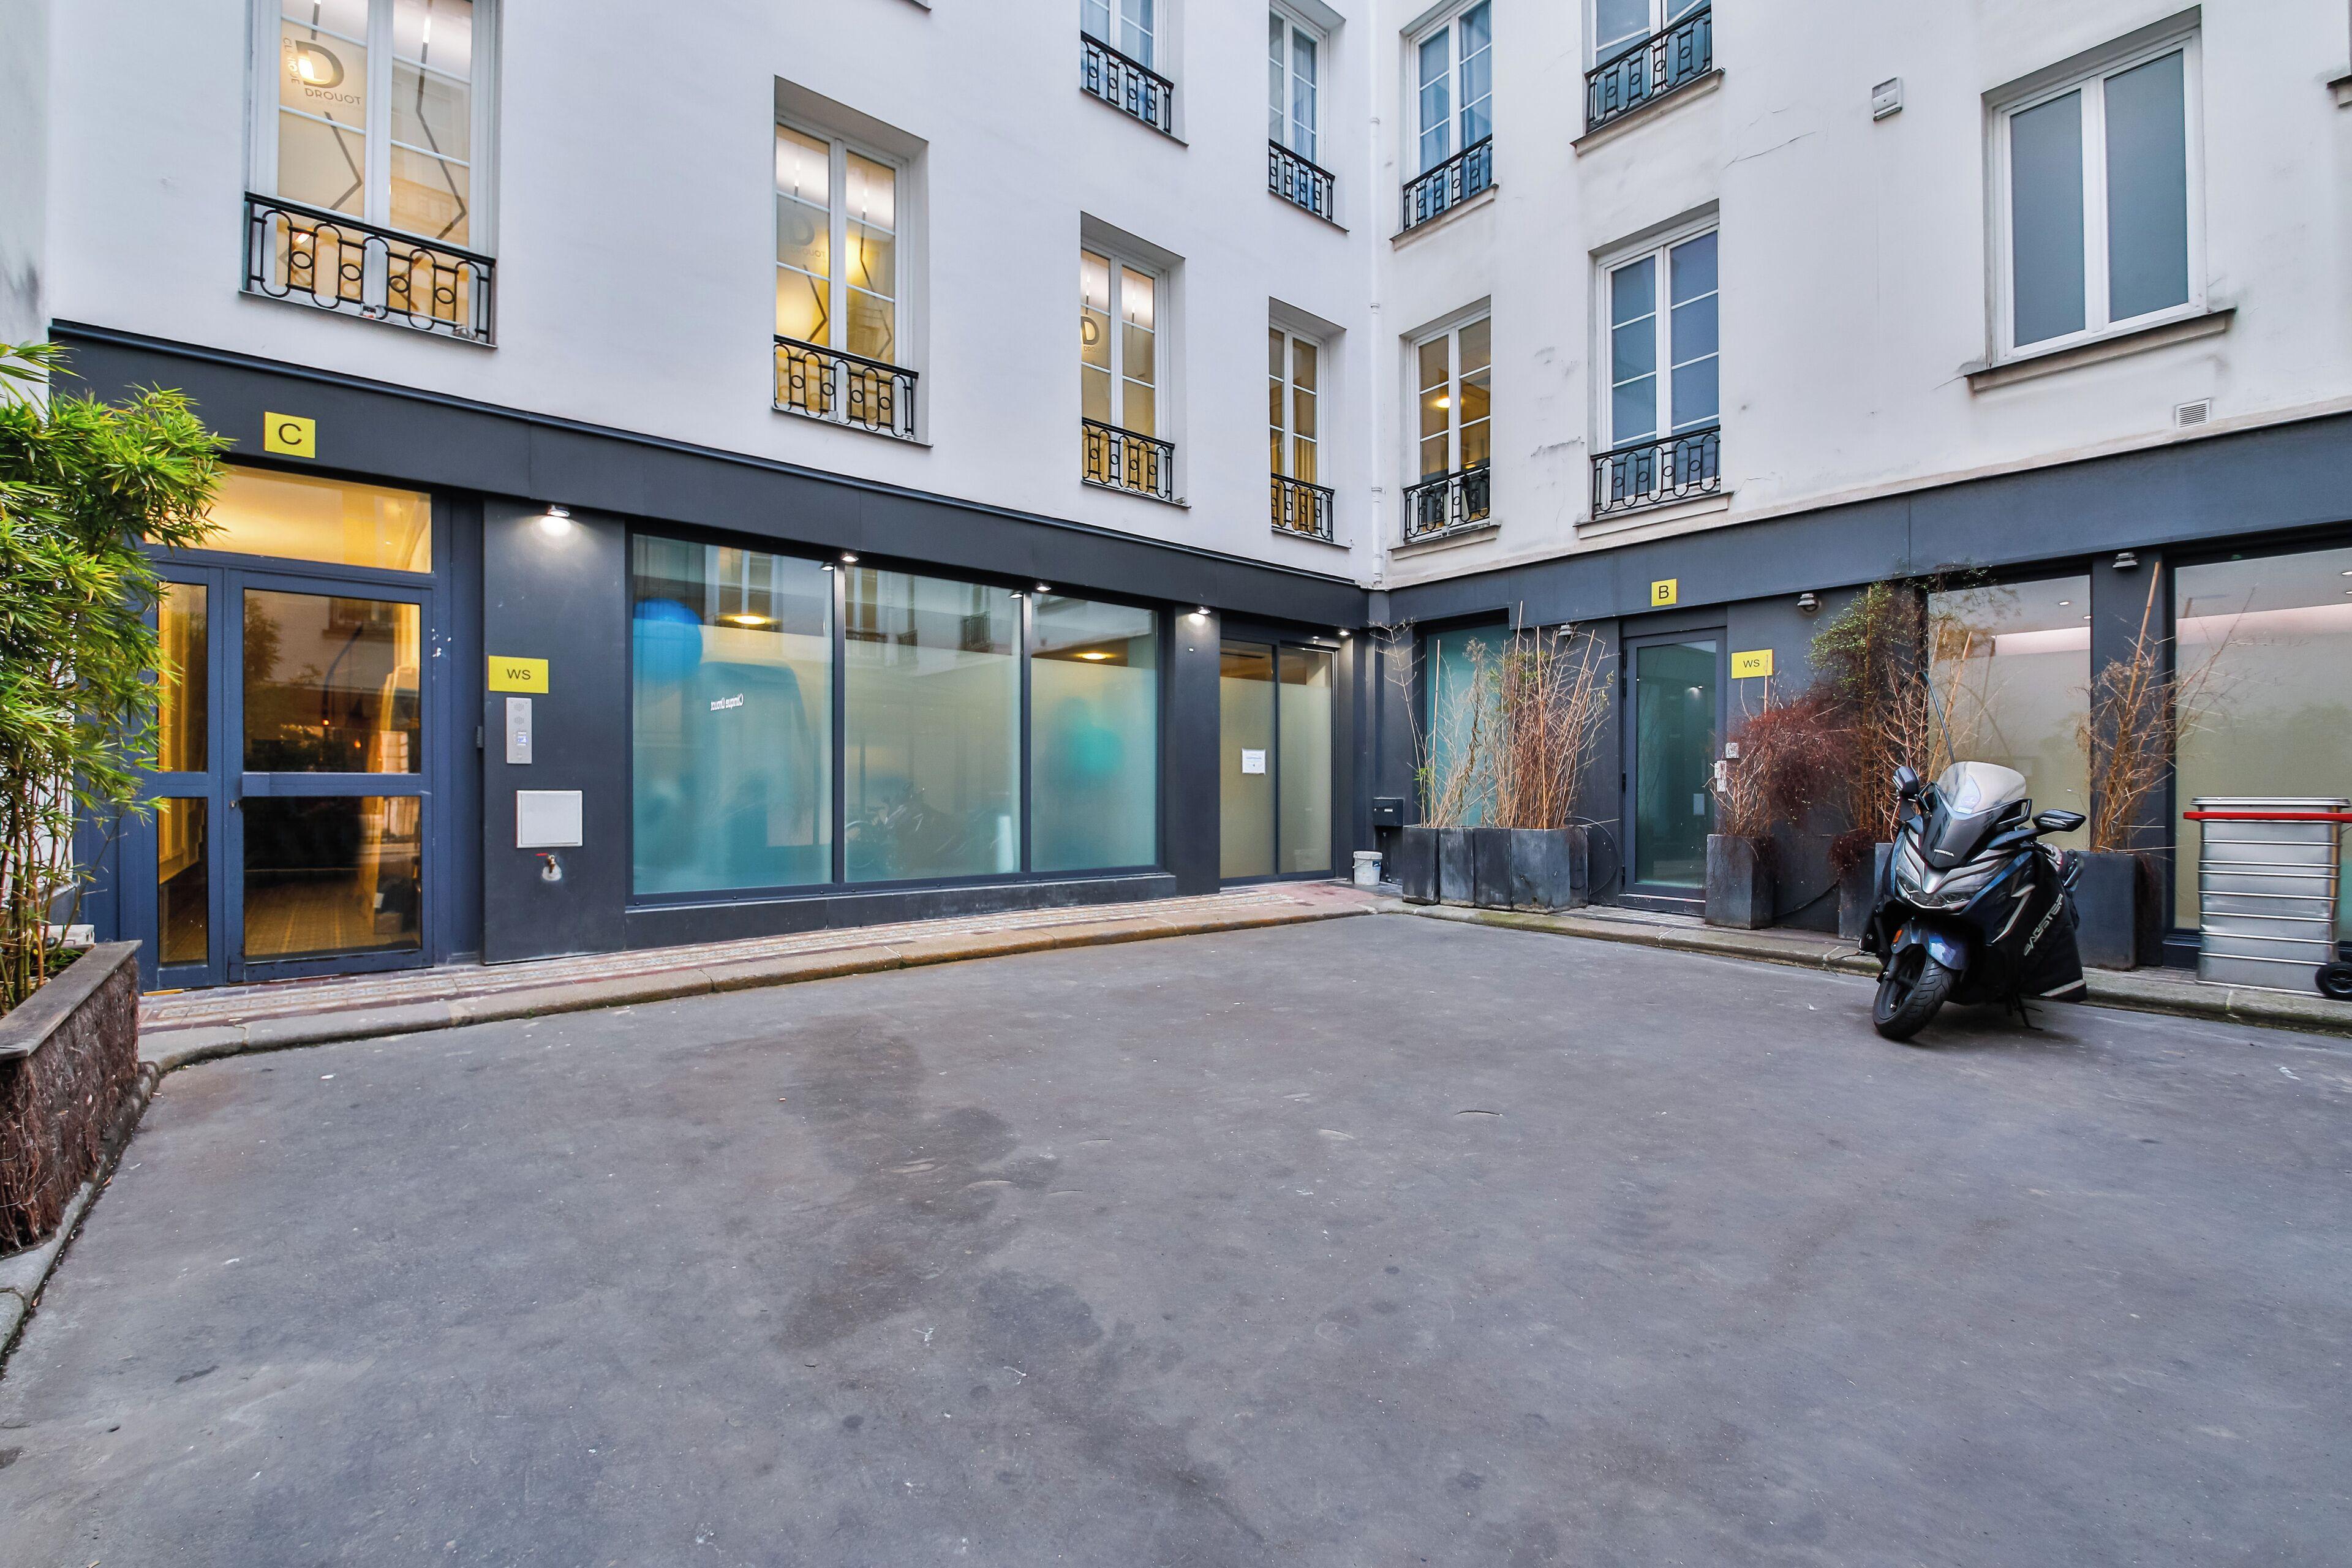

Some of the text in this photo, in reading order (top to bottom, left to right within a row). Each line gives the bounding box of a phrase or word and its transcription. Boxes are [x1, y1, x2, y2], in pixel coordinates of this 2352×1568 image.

[304, 88, 361, 105] DROUOT
[279, 423, 302, 445] C
[1659, 586, 1669, 599] B
[1743, 659, 1760, 668] WS
[507, 669, 531, 680] WS
[1934, 848, 1954, 857] HONDA
[2024, 893, 2063, 956] BAGSTER
